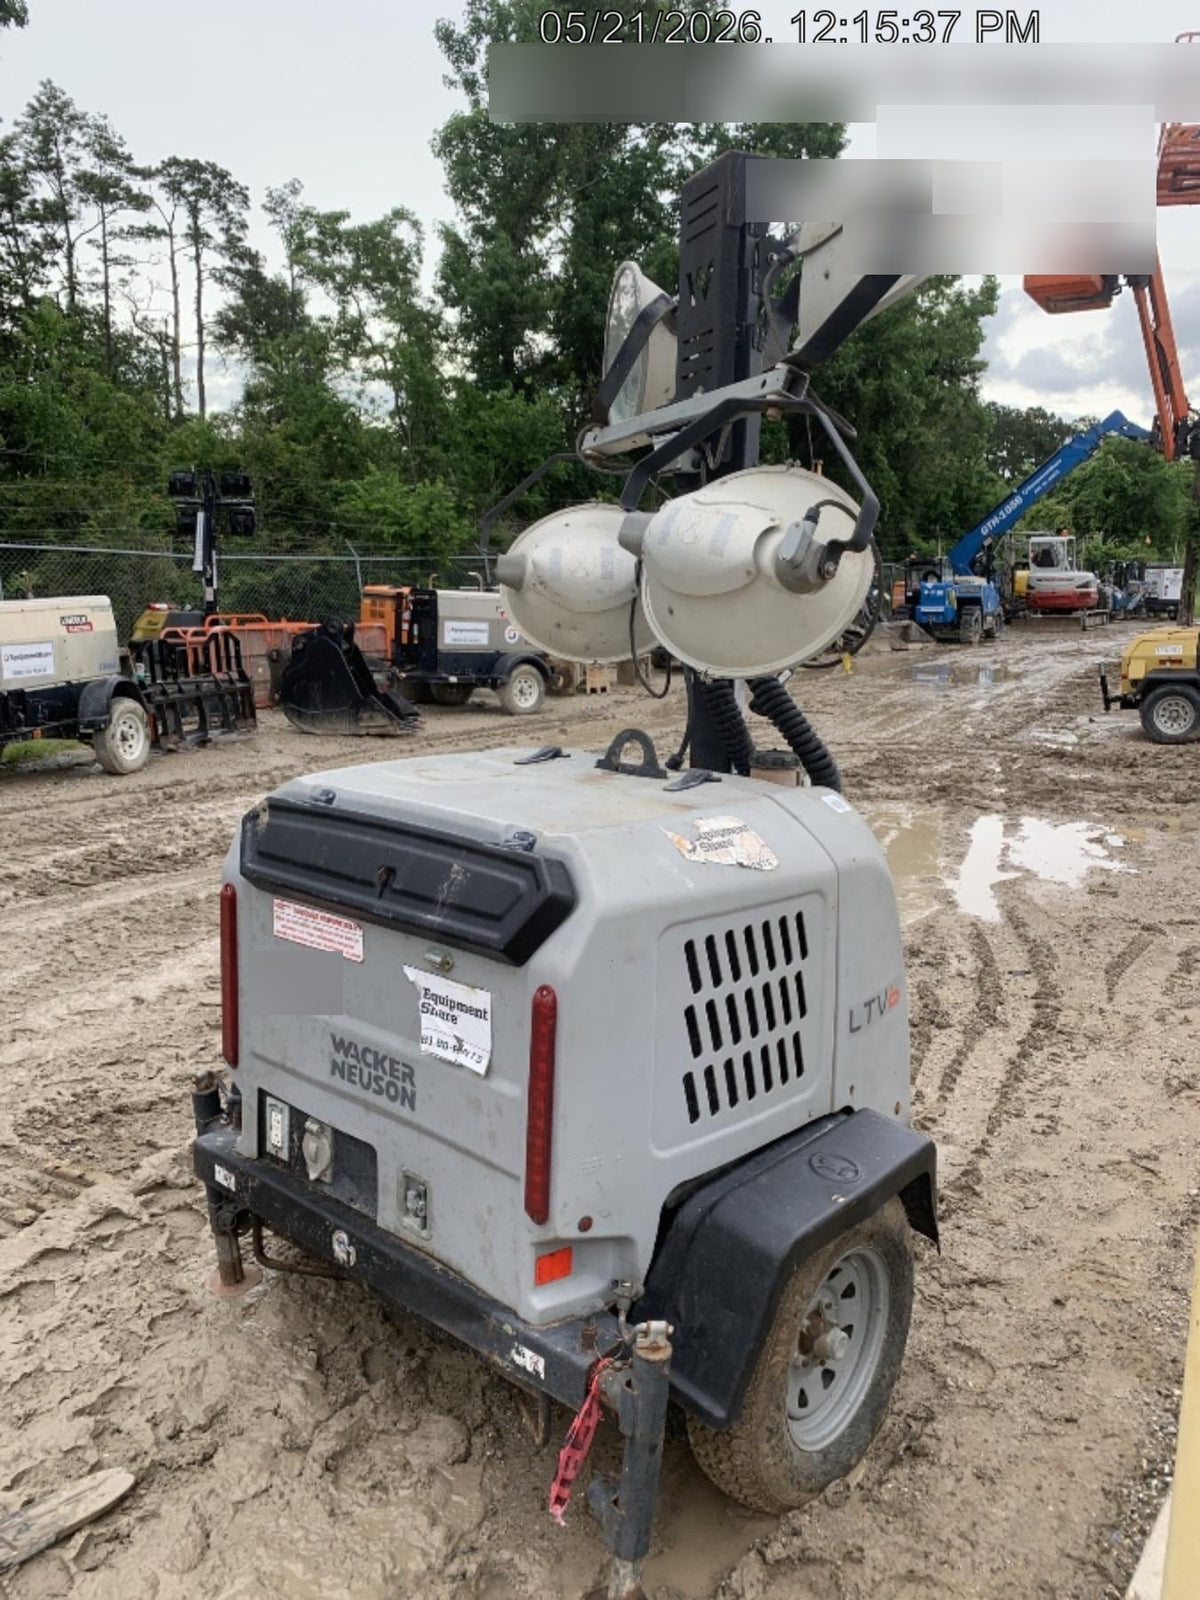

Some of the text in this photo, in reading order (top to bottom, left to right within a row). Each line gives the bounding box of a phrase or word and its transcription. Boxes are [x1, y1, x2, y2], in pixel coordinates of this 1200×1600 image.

[421, 1002, 458, 1024] Share
[423, 987, 488, 1021] Equipment
[330, 1033, 416, 1088] WACKER
[330, 1059, 416, 1112] NEUSON
